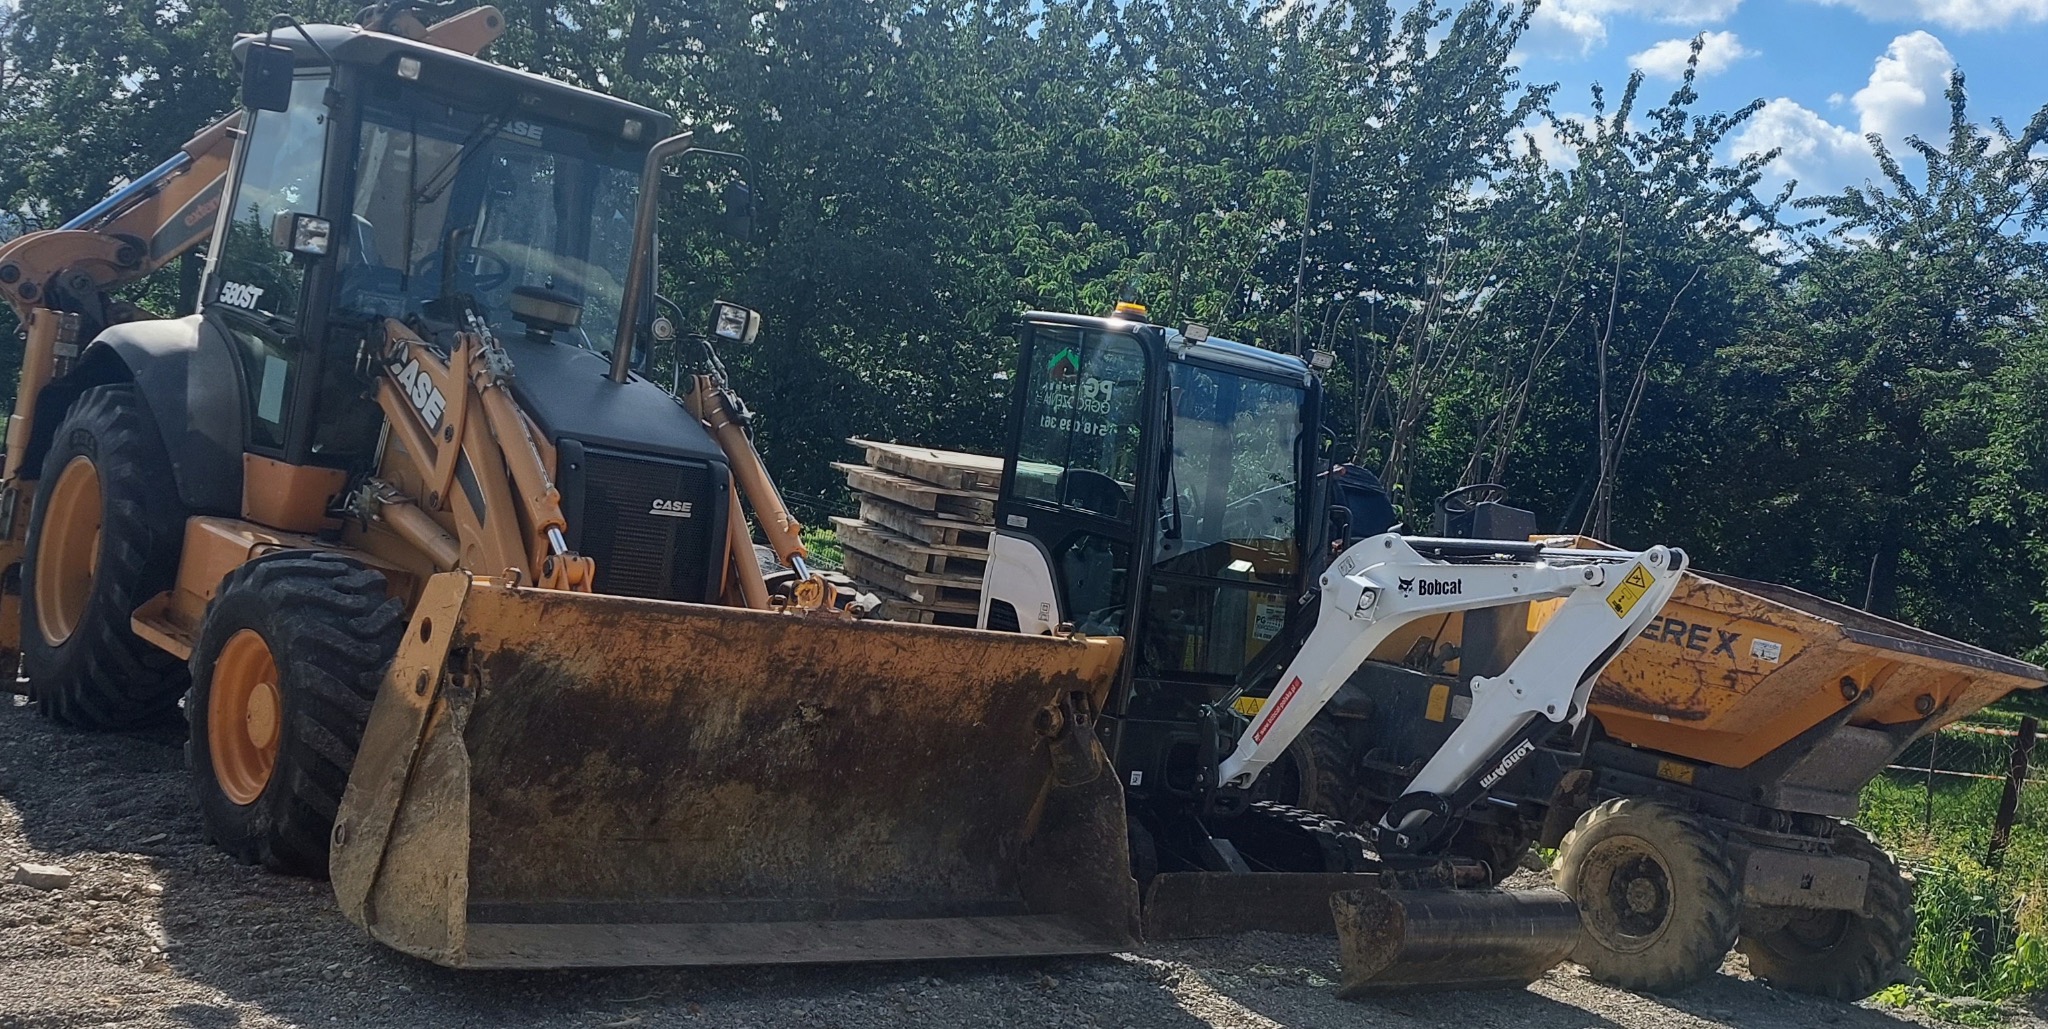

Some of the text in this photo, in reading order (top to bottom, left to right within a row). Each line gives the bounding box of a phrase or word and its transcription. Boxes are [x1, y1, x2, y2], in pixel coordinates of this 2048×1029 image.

[220, 281, 264, 309] 580ST
[652, 499, 693, 512] CASE
[1419, 579, 1462, 595] Bobcat
[1640, 615, 1742, 660] EREX
[1480, 738, 1536, 788] LongArm
